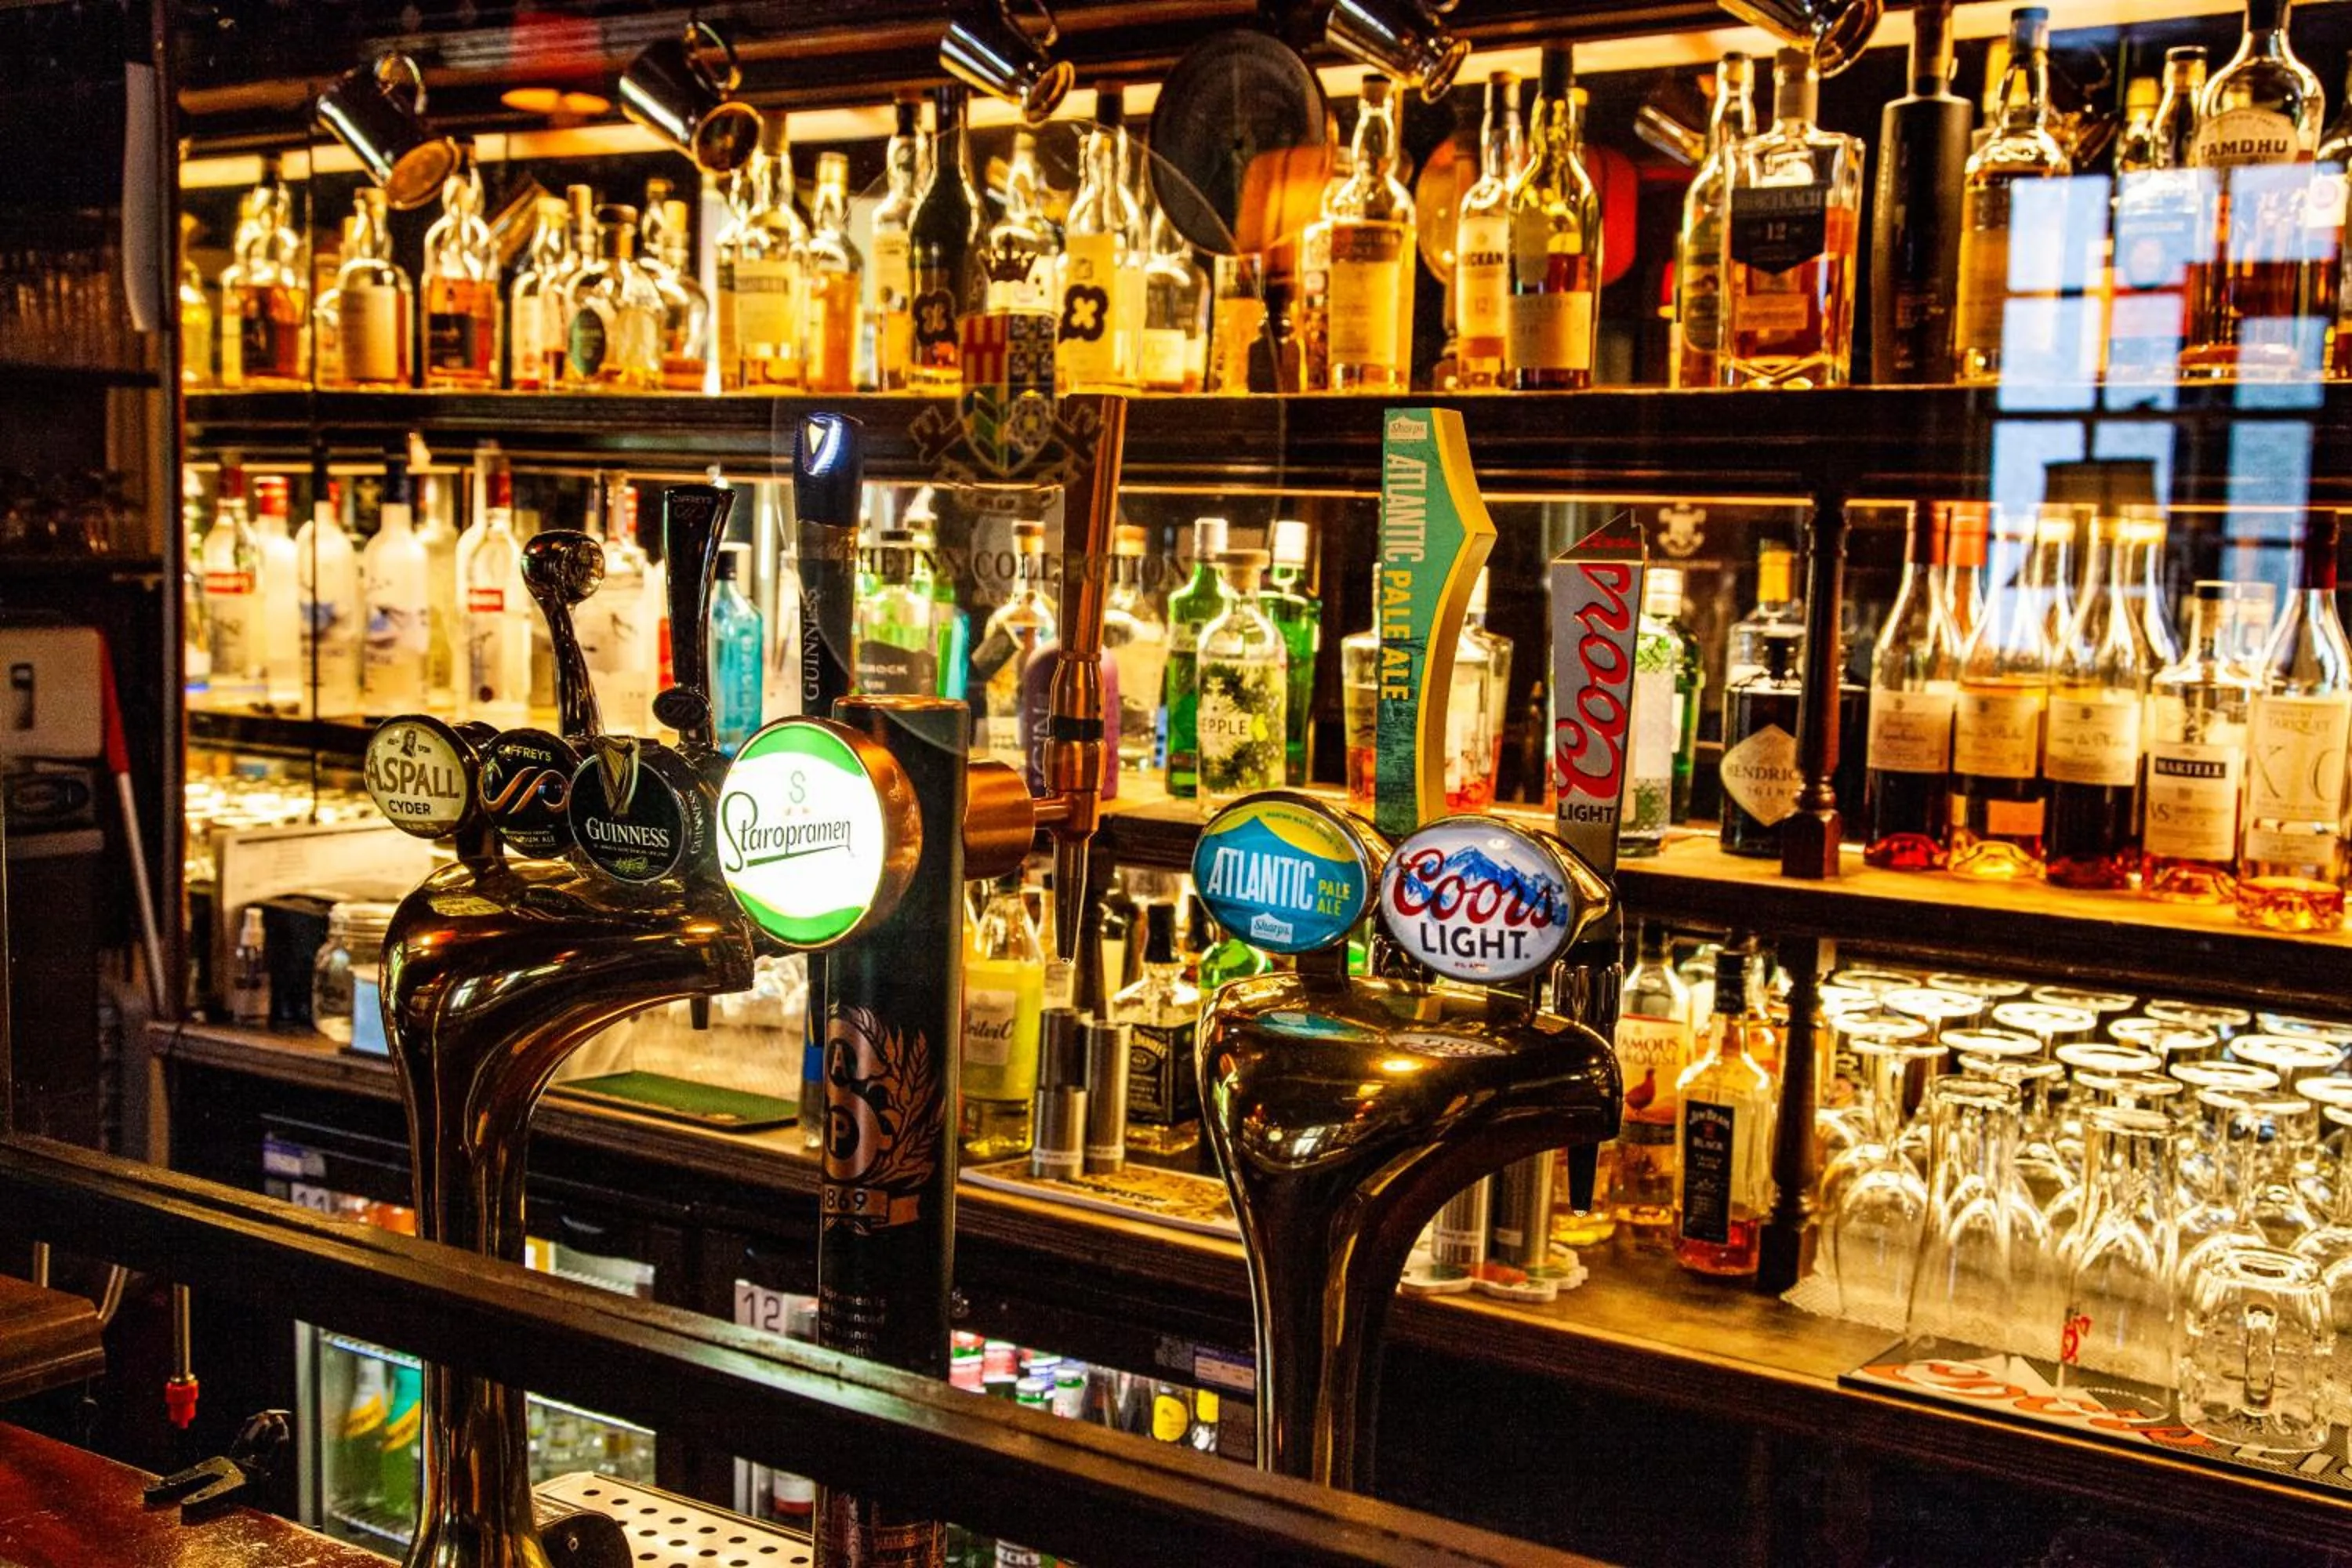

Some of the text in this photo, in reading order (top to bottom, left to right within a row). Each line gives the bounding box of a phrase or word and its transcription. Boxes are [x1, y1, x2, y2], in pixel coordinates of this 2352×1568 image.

[2200, 139, 2288, 158] TAMDHU
[1381, 452, 1427, 701] ATLANTIC PALE ALE
[804, 588, 820, 702] GUINNESS
[1555, 562, 1632, 800] Coors
[1202, 717, 1247, 735] EPPLE
[368, 749, 460, 798] ASPALL
[1726, 764, 1797, 781] HENDRIC
[2156, 758, 2223, 776] MARTELL
[388, 800, 431, 815] CYDER
[1557, 804, 1614, 824] LIGHT
[586, 817, 670, 848] GUINNESS
[721, 791, 851, 873] Staropramen
[1207, 846, 1316, 911] ATLANTIC
[1317, 878, 1351, 900] PALE
[1392, 848, 1553, 929] Coors
[1316, 899, 1342, 916] ALE
[1617, 1033, 1679, 1052] FAMOUS
[1620, 1051, 1678, 1065] ROUSE
[822, 1188, 868, 1211] 869
[742, 1291, 782, 1333] 12
